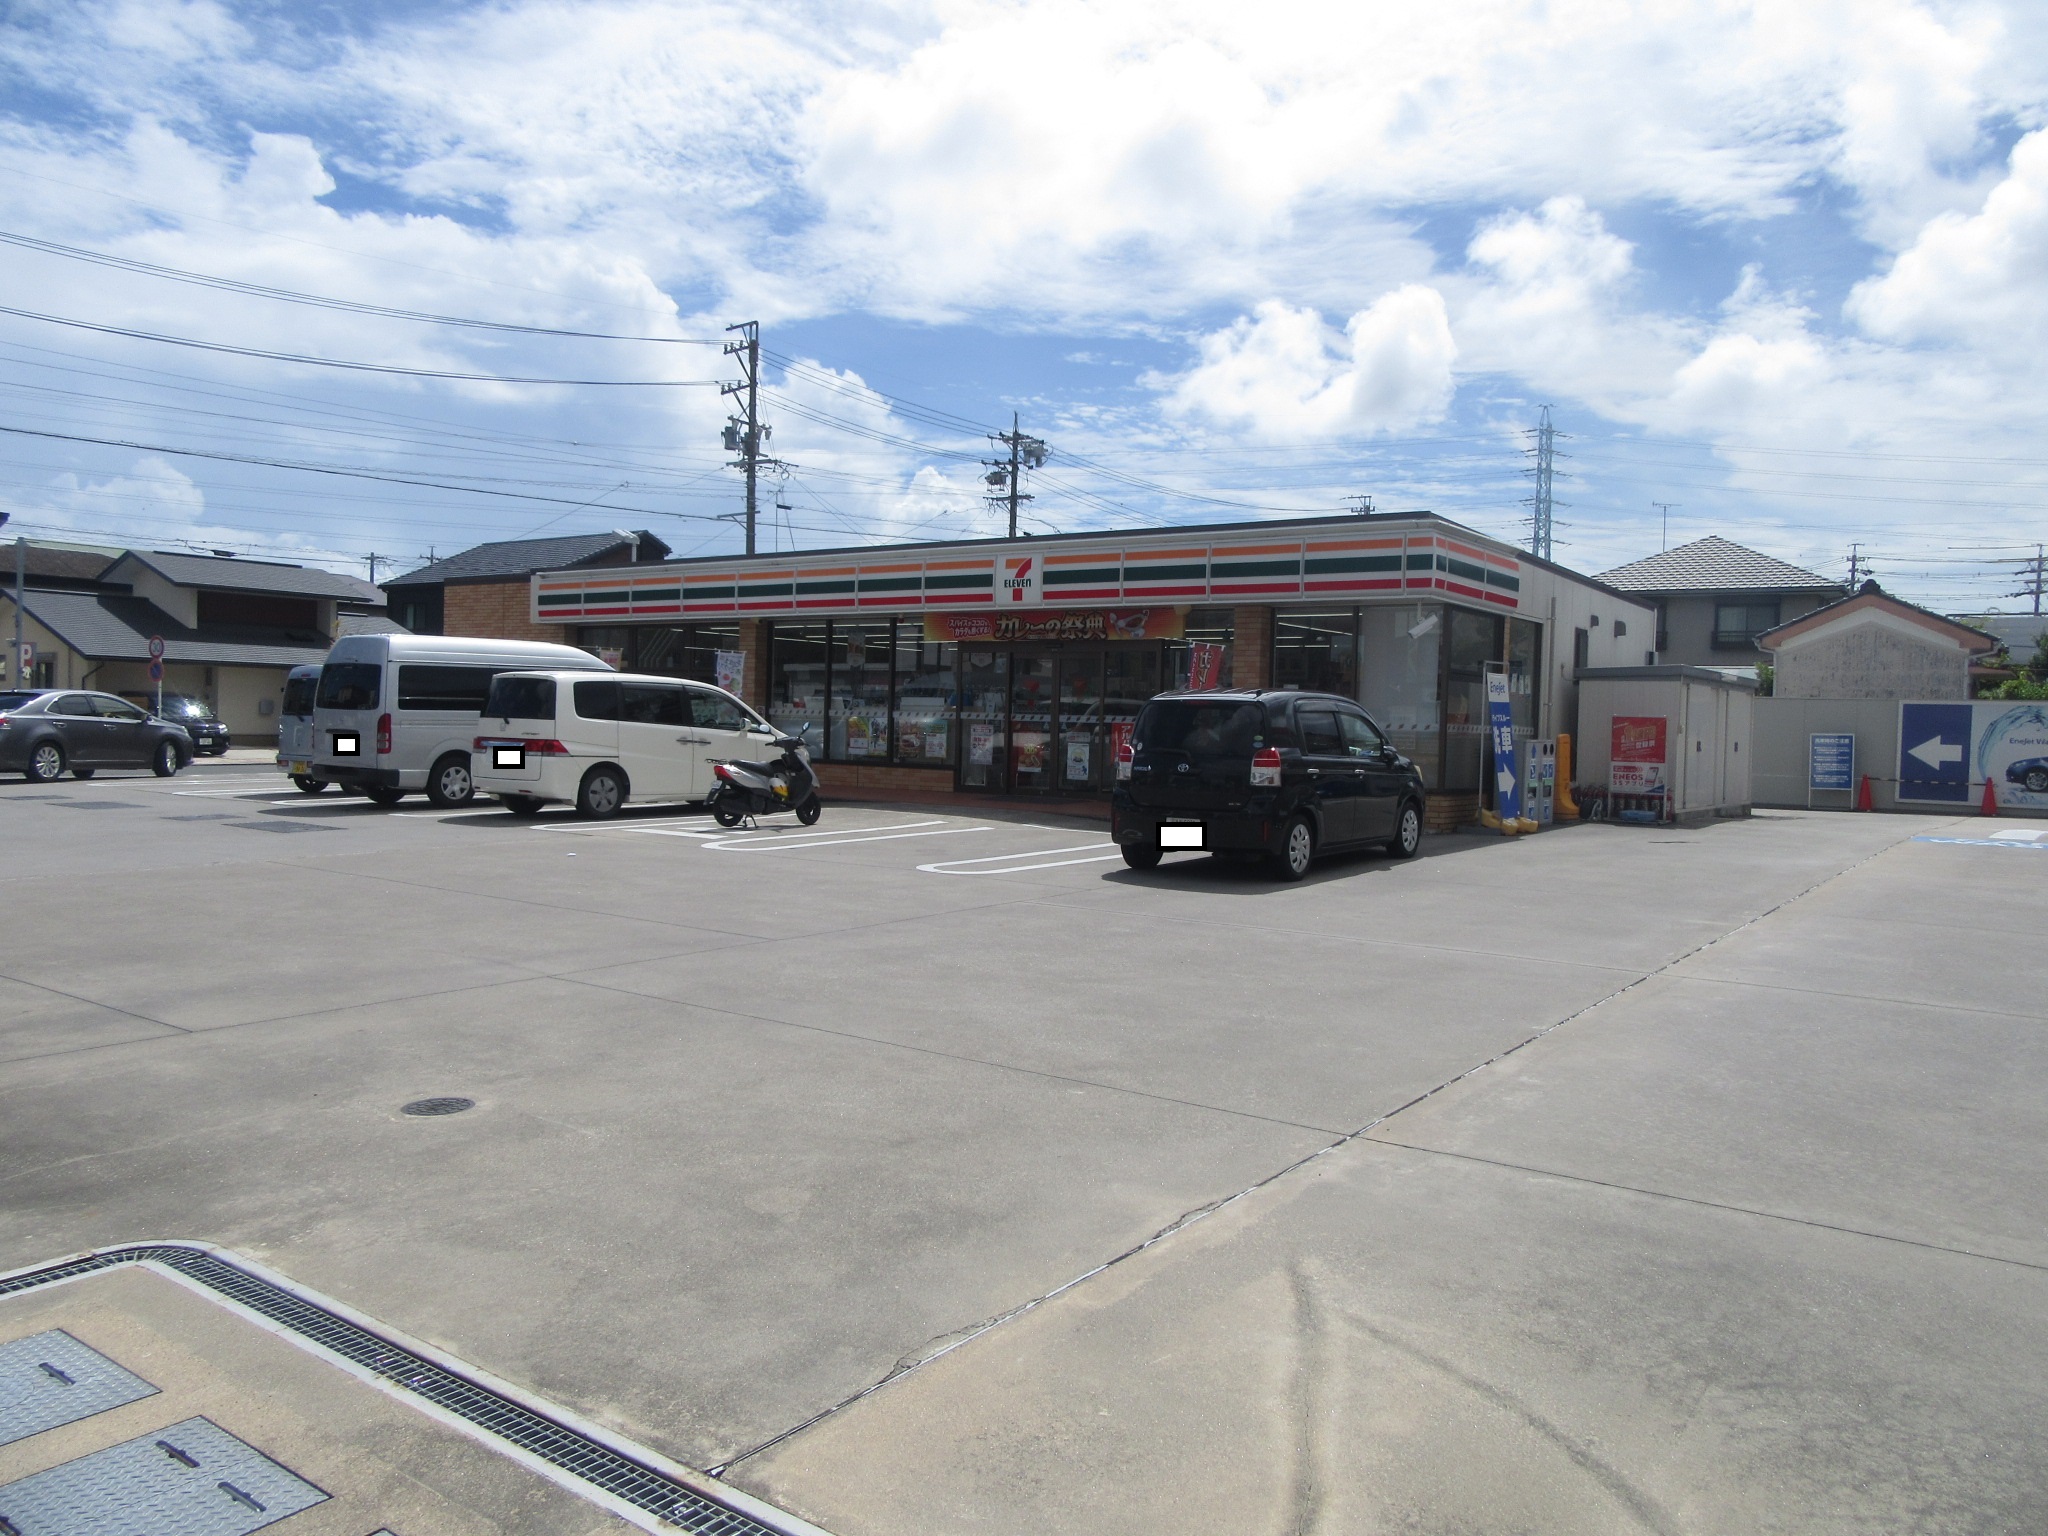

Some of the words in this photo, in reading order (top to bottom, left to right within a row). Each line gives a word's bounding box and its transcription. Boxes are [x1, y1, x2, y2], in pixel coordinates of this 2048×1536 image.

[1005, 557, 1033, 602] 7
[996, 613, 1107, 640] カレーの祭典
[20, 644, 32, 668] P
[152, 642, 161, 653] 30
[1613, 773, 1643, 781] ENEOS
